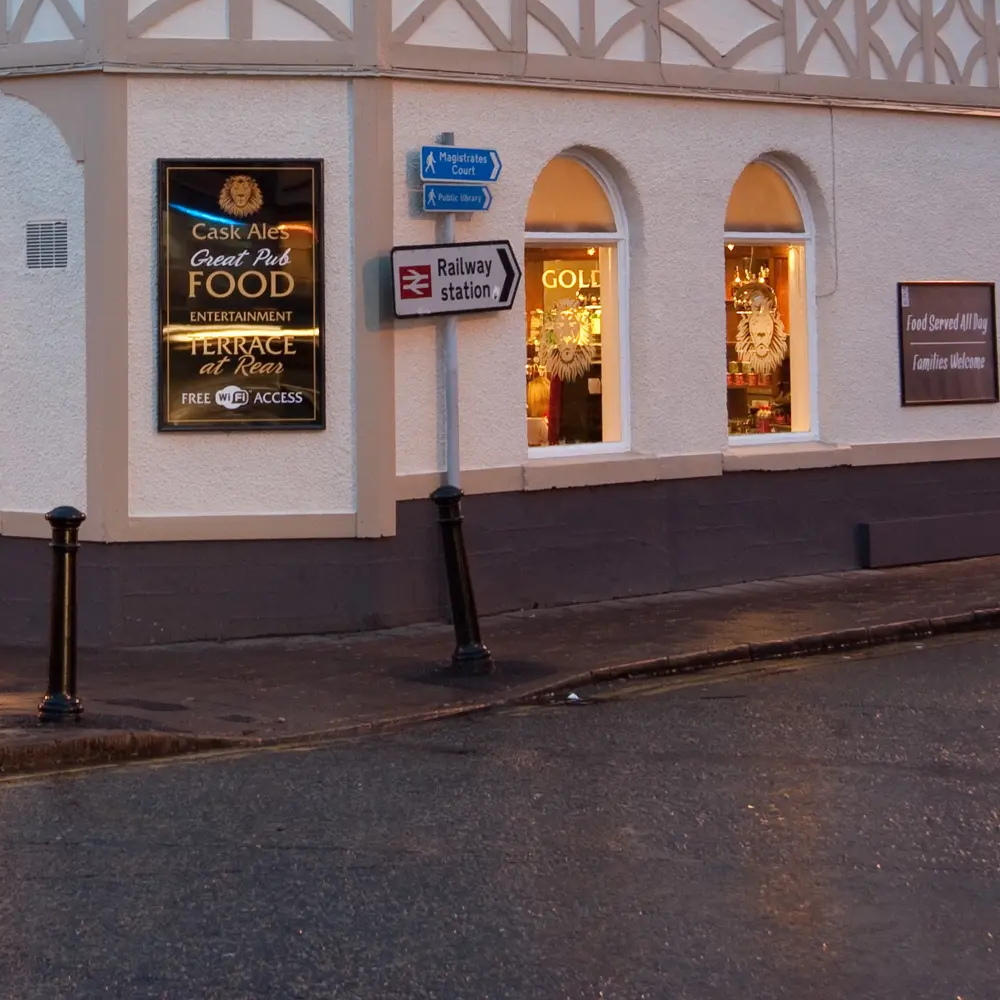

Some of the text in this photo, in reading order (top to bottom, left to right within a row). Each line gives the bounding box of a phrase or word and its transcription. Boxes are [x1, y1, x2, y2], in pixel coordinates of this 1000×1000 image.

[439, 151, 488, 164] Magistrates
[451, 165, 476, 175] Court
[438, 192, 459, 203] Public
[192, 223, 290, 240] Cask Ales
[190, 247, 292, 267] Great Pub
[437, 258, 492, 277] Railway
[188, 270, 295, 298] FOOD
[441, 281, 491, 301] station
[190, 311, 293, 322] ENTERTAINMENT
[906, 312, 988, 335] Food Served All Day
[188, 335, 297, 355] TERRACE
[200, 354, 285, 376] at Rear
[912, 351, 986, 371] Families Welcome
[181, 392, 211, 404] FREE
[253, 392, 303, 404] ACCESS
